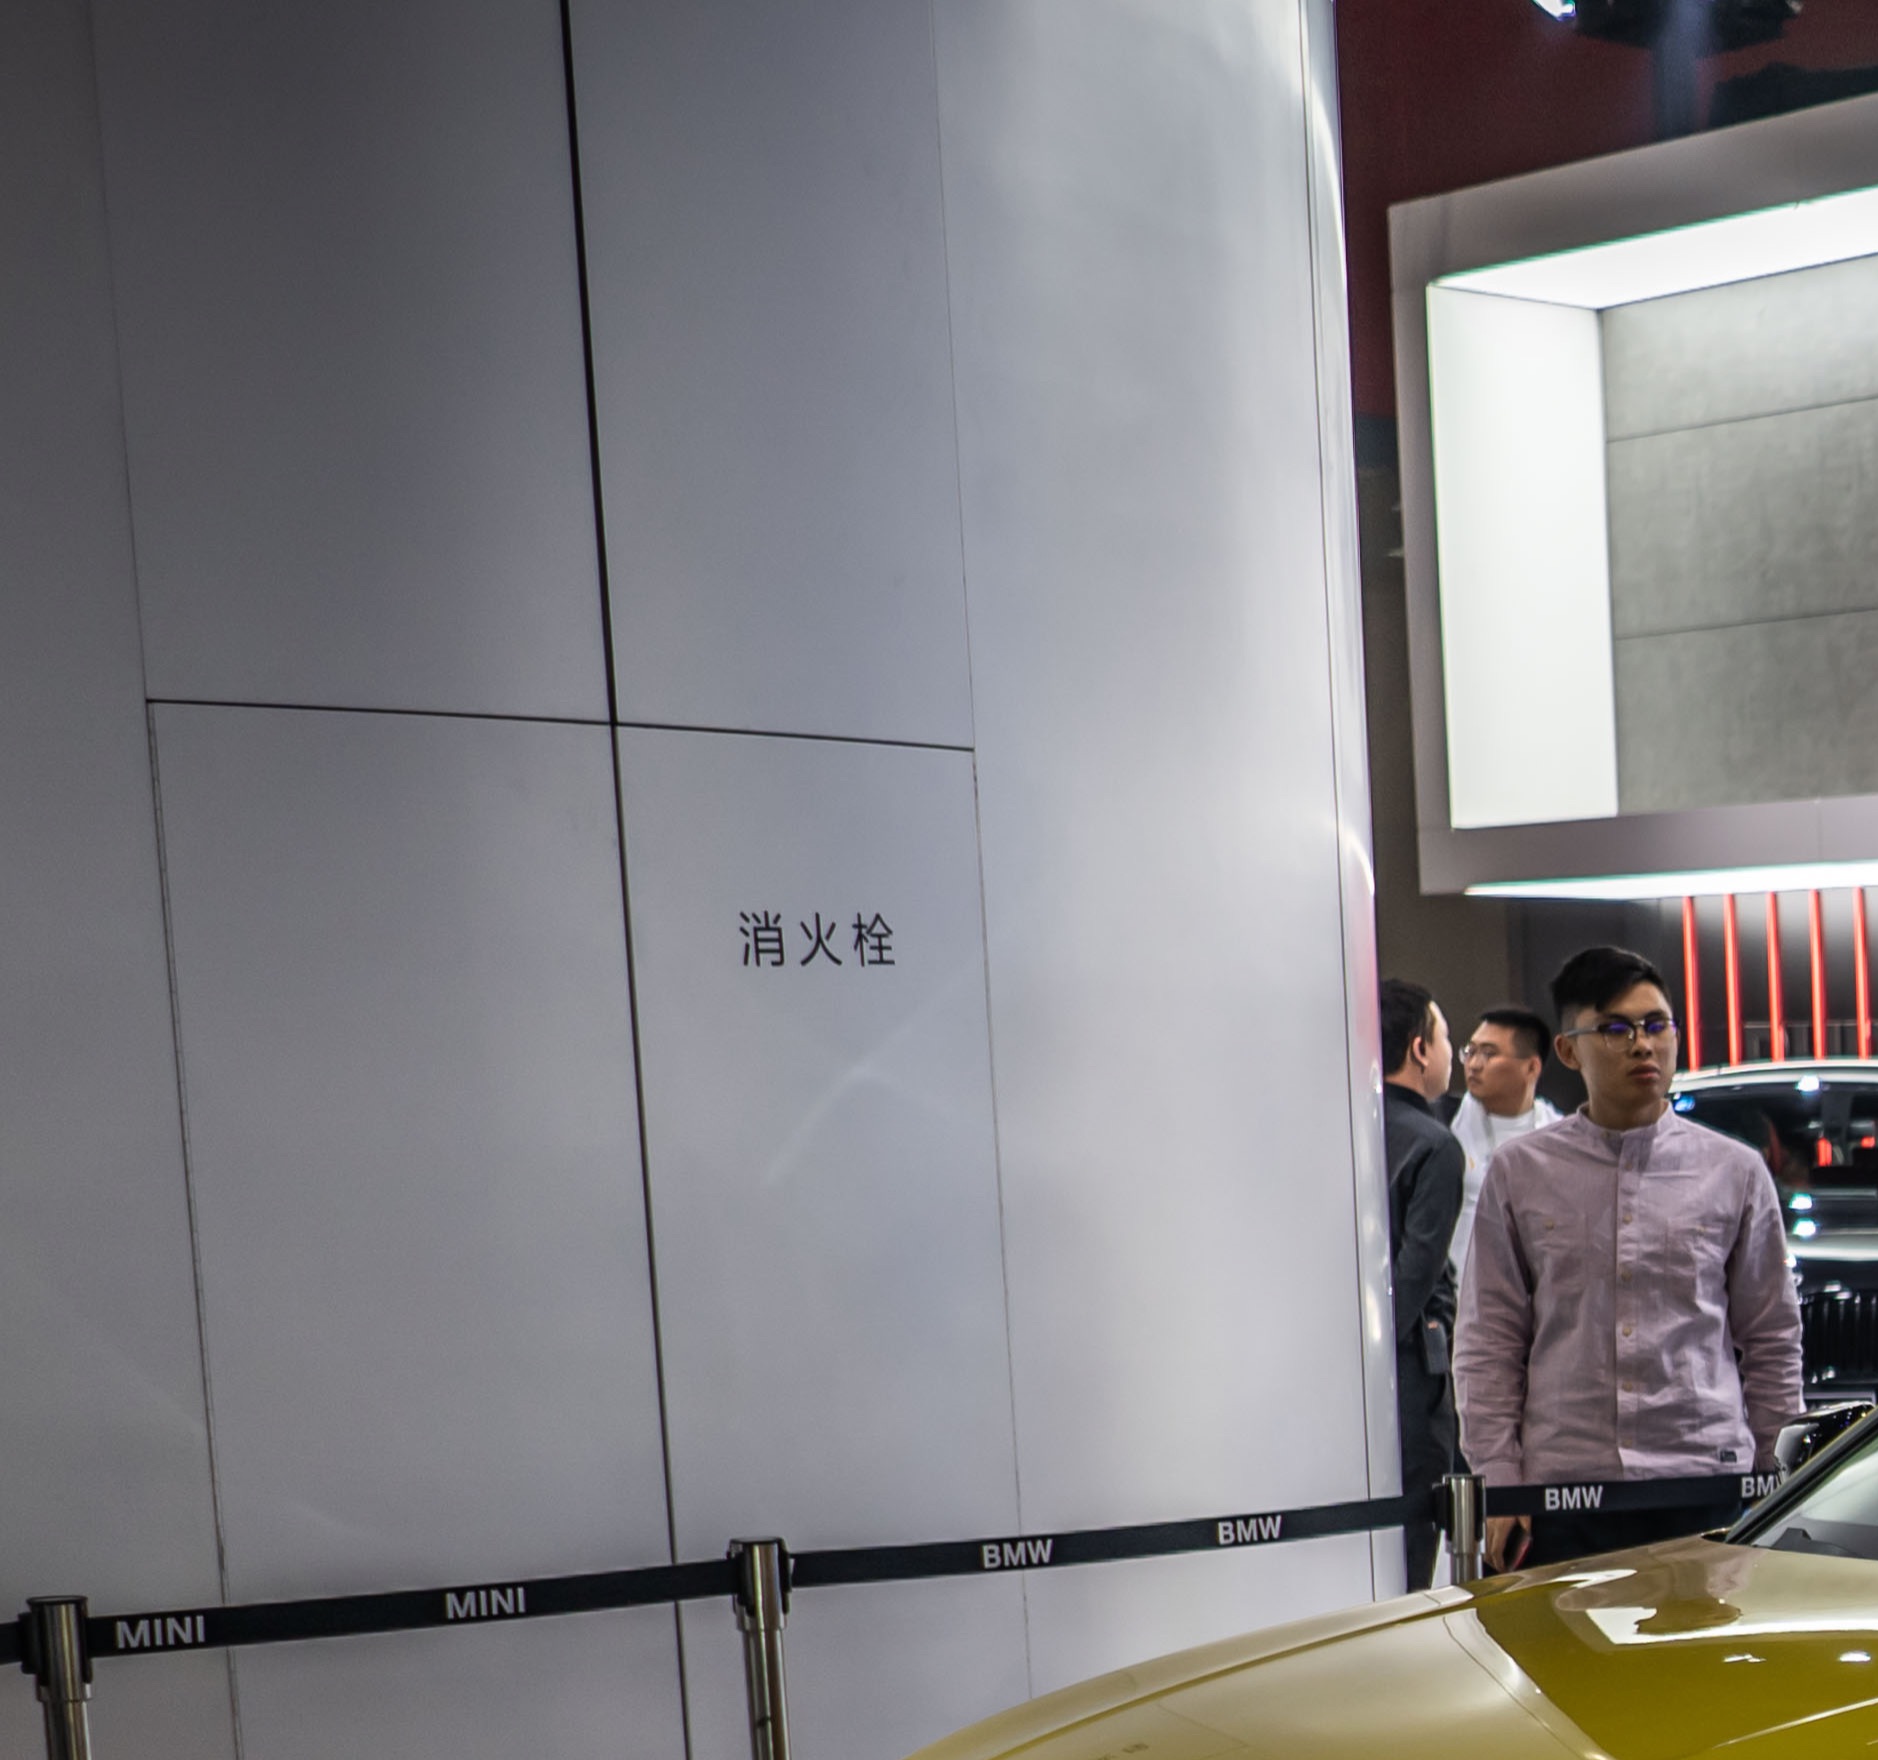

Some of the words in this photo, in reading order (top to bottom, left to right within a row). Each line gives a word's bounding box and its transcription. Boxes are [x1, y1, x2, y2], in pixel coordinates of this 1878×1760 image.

[740, 910, 896, 967] 消火栓
[1544, 1485, 1603, 1513] BMW
[982, 1538, 1053, 1569] BMW
[1217, 1514, 1282, 1546] BMW
[116, 1615, 205, 1649] MINI
[446, 1587, 527, 1619] MINI
